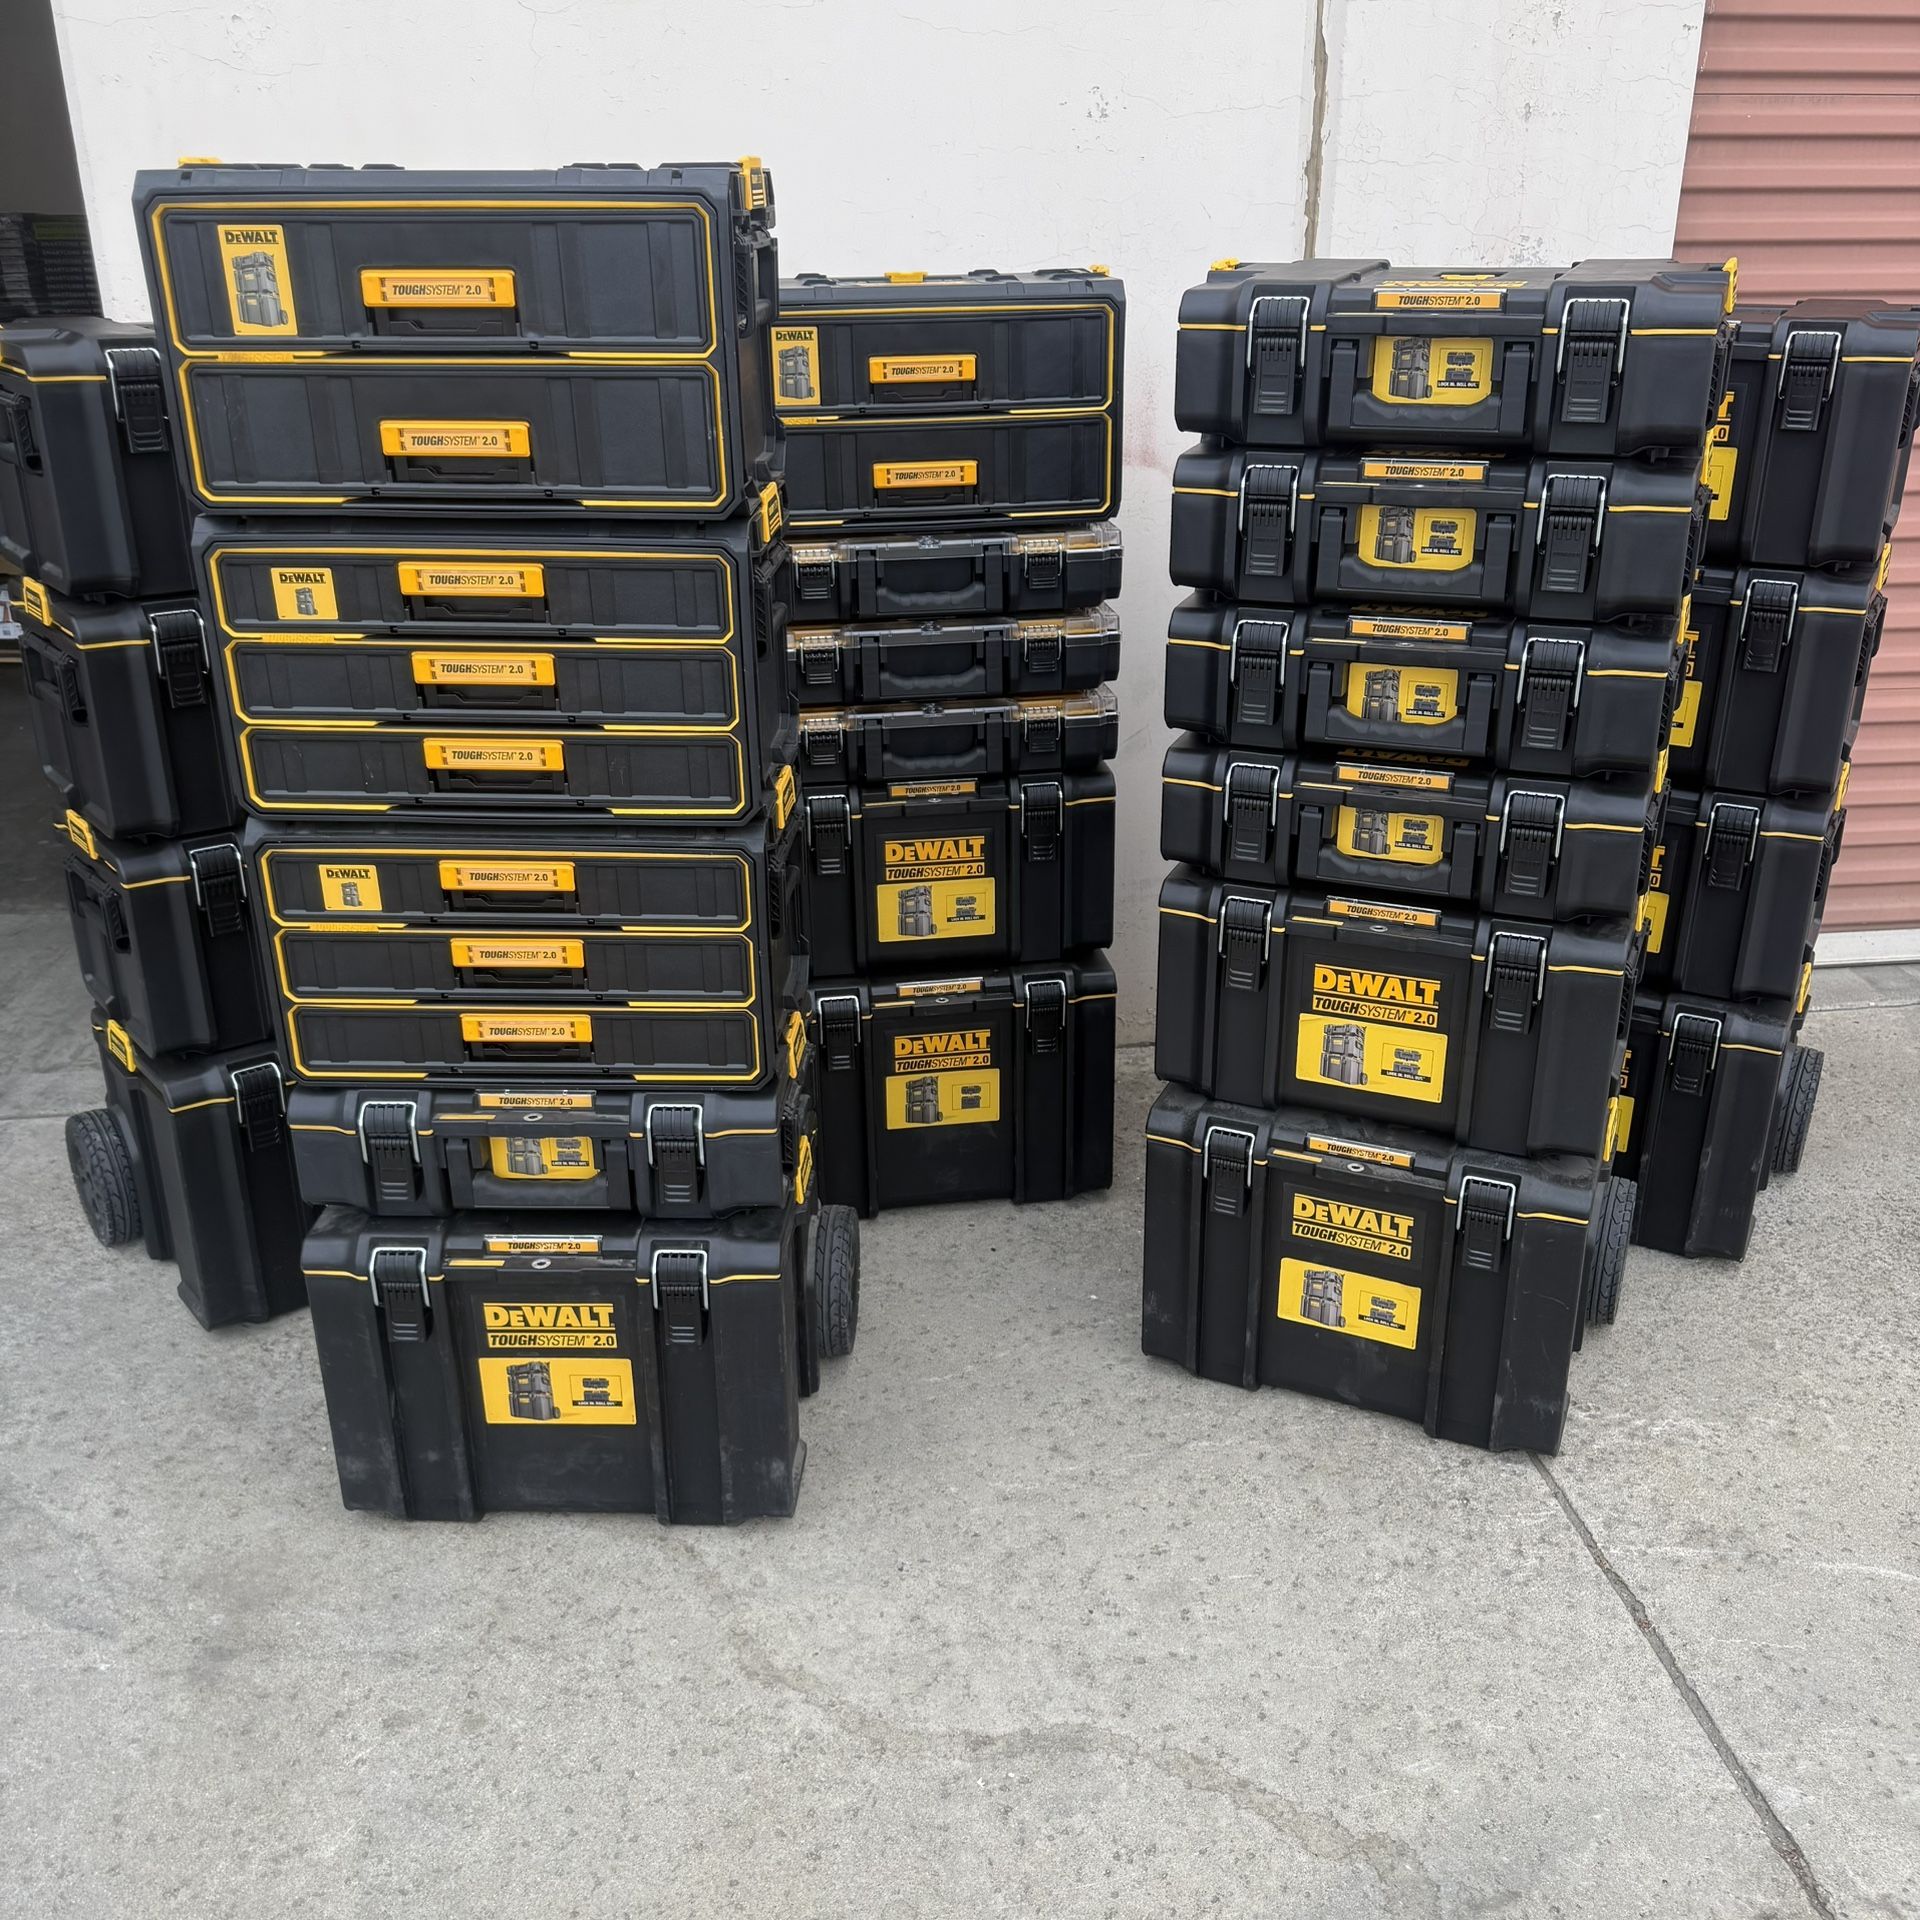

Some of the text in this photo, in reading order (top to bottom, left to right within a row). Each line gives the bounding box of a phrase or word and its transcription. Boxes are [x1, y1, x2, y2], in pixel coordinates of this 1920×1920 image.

[224, 230, 279, 244] DEWALT
[466, 285, 481, 296] 2.0
[1466, 296, 1480, 305] 2.0
[776, 331, 814, 341] DEWALT
[1712, 426, 1728, 440] .0
[482, 436, 498, 446] 2.0
[1450, 466, 1464, 477] 2.0
[279, 572, 325, 584] DEWALT
[499, 575, 514, 585] 2.0
[1434, 627, 1448, 636] 2.0
[509, 665, 524, 674] 2.0
[519, 751, 533, 760] 2.0
[1418, 777, 1431, 785] 2.0
[885, 838, 985, 863] DEWALT
[326, 868, 371, 879] DEWALT
[967, 864, 984, 875] 2.0
[534, 872, 549, 881] 2.0
[1404, 913, 1418, 921] 2.0
[543, 951, 557, 959] 2.0
[1314, 965, 1441, 1006] DEWALT
[1413, 1012, 1435, 1026] 2.0
[552, 1027, 565, 1036] 2.0
[895, 1031, 991, 1056] DEWALT
[973, 1056, 989, 1065] 2.0
[560, 1098, 573, 1106] 2.0
[1382, 1154, 1394, 1162] 2.0
[1293, 1195, 1414, 1239] DEWALT
[568, 1242, 581, 1250] 2.0
[1388, 1244, 1409, 1257] 2.0
[484, 1305, 615, 1328] DEWALT
[593, 1335, 615, 1346] 2.0
